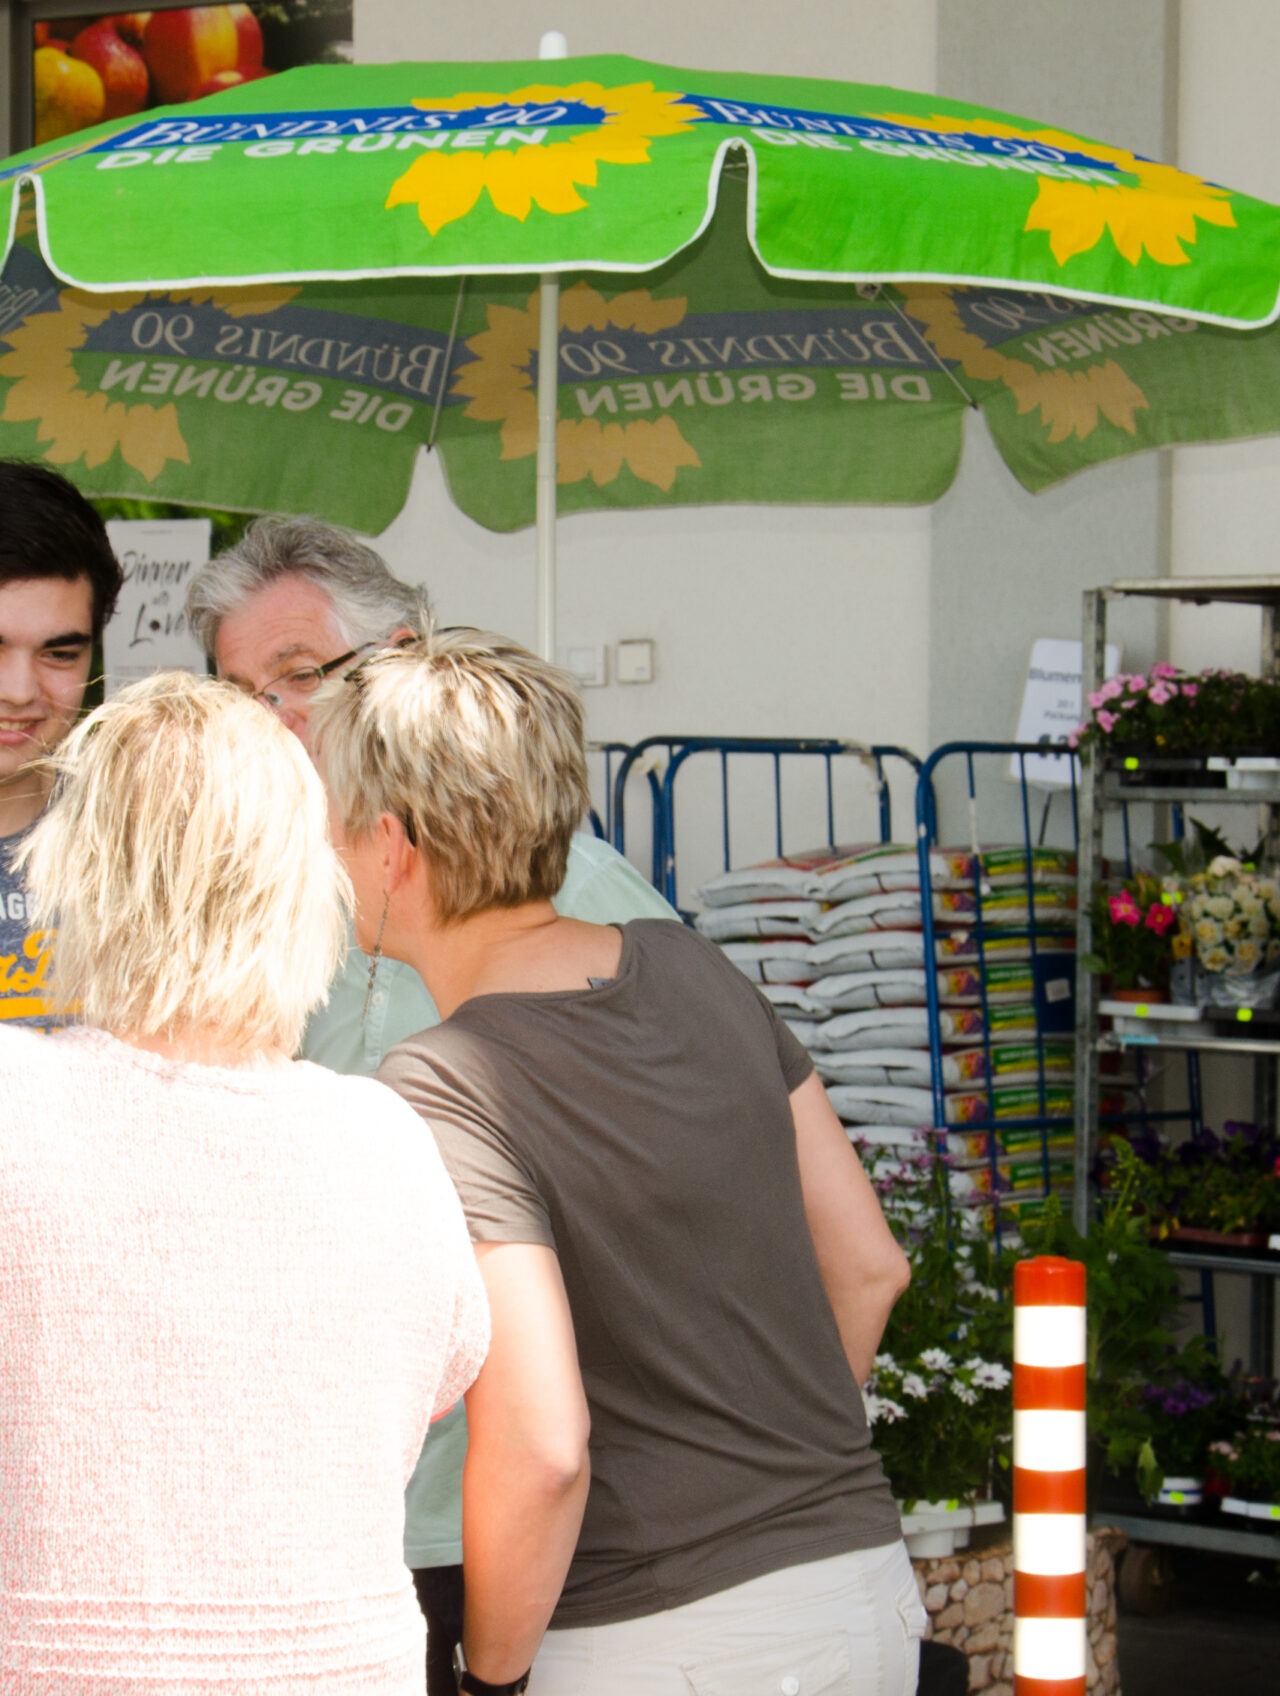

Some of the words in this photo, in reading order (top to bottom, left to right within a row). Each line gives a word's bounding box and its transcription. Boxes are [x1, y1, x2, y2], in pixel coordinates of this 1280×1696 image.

[468, 105, 568, 129] 90
[96, 144, 224, 170] DIE
[244, 127, 549, 159] GRÜNEN
[750, 127, 854, 152] DIE
[859, 137, 1119, 187] GRÜNEN
[993, 139, 1066, 163] 90
[1028, 667, 1082, 684] Blumen
